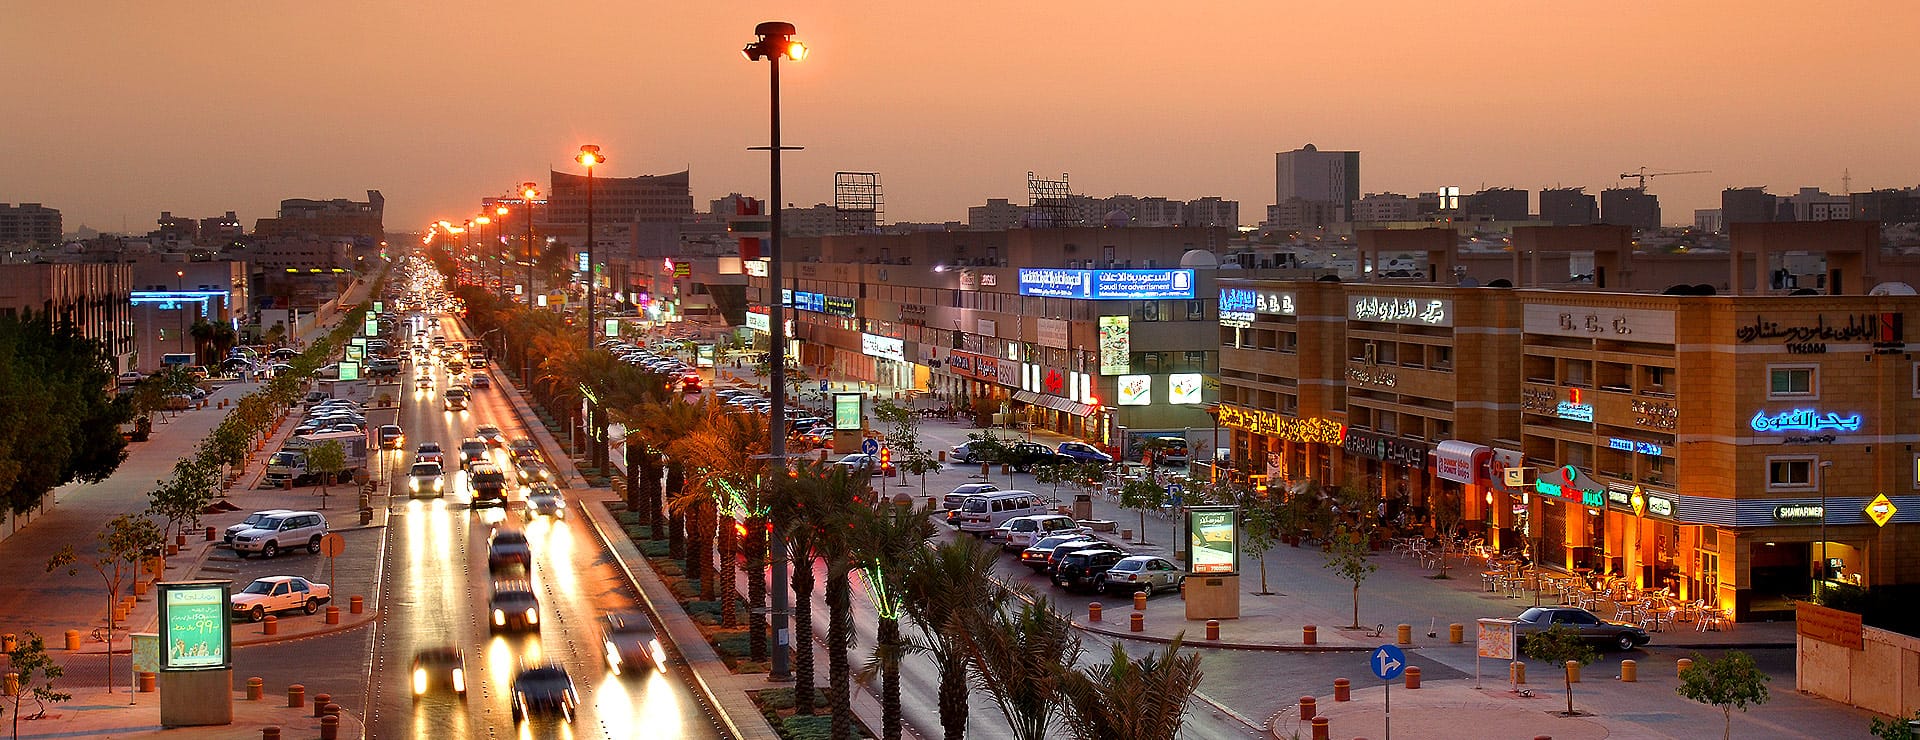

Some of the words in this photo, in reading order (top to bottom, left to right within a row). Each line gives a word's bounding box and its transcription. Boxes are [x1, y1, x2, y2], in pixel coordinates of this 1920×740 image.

[1127, 272, 1170, 284] السعودية
[1751, 408, 1815, 431] الفنون
[1815, 412, 1860, 431] بحر
[1170, 486, 1180, 499] P
[1780, 507, 1824, 518] SHAWARMER
[196, 620, 213, 634] 99
